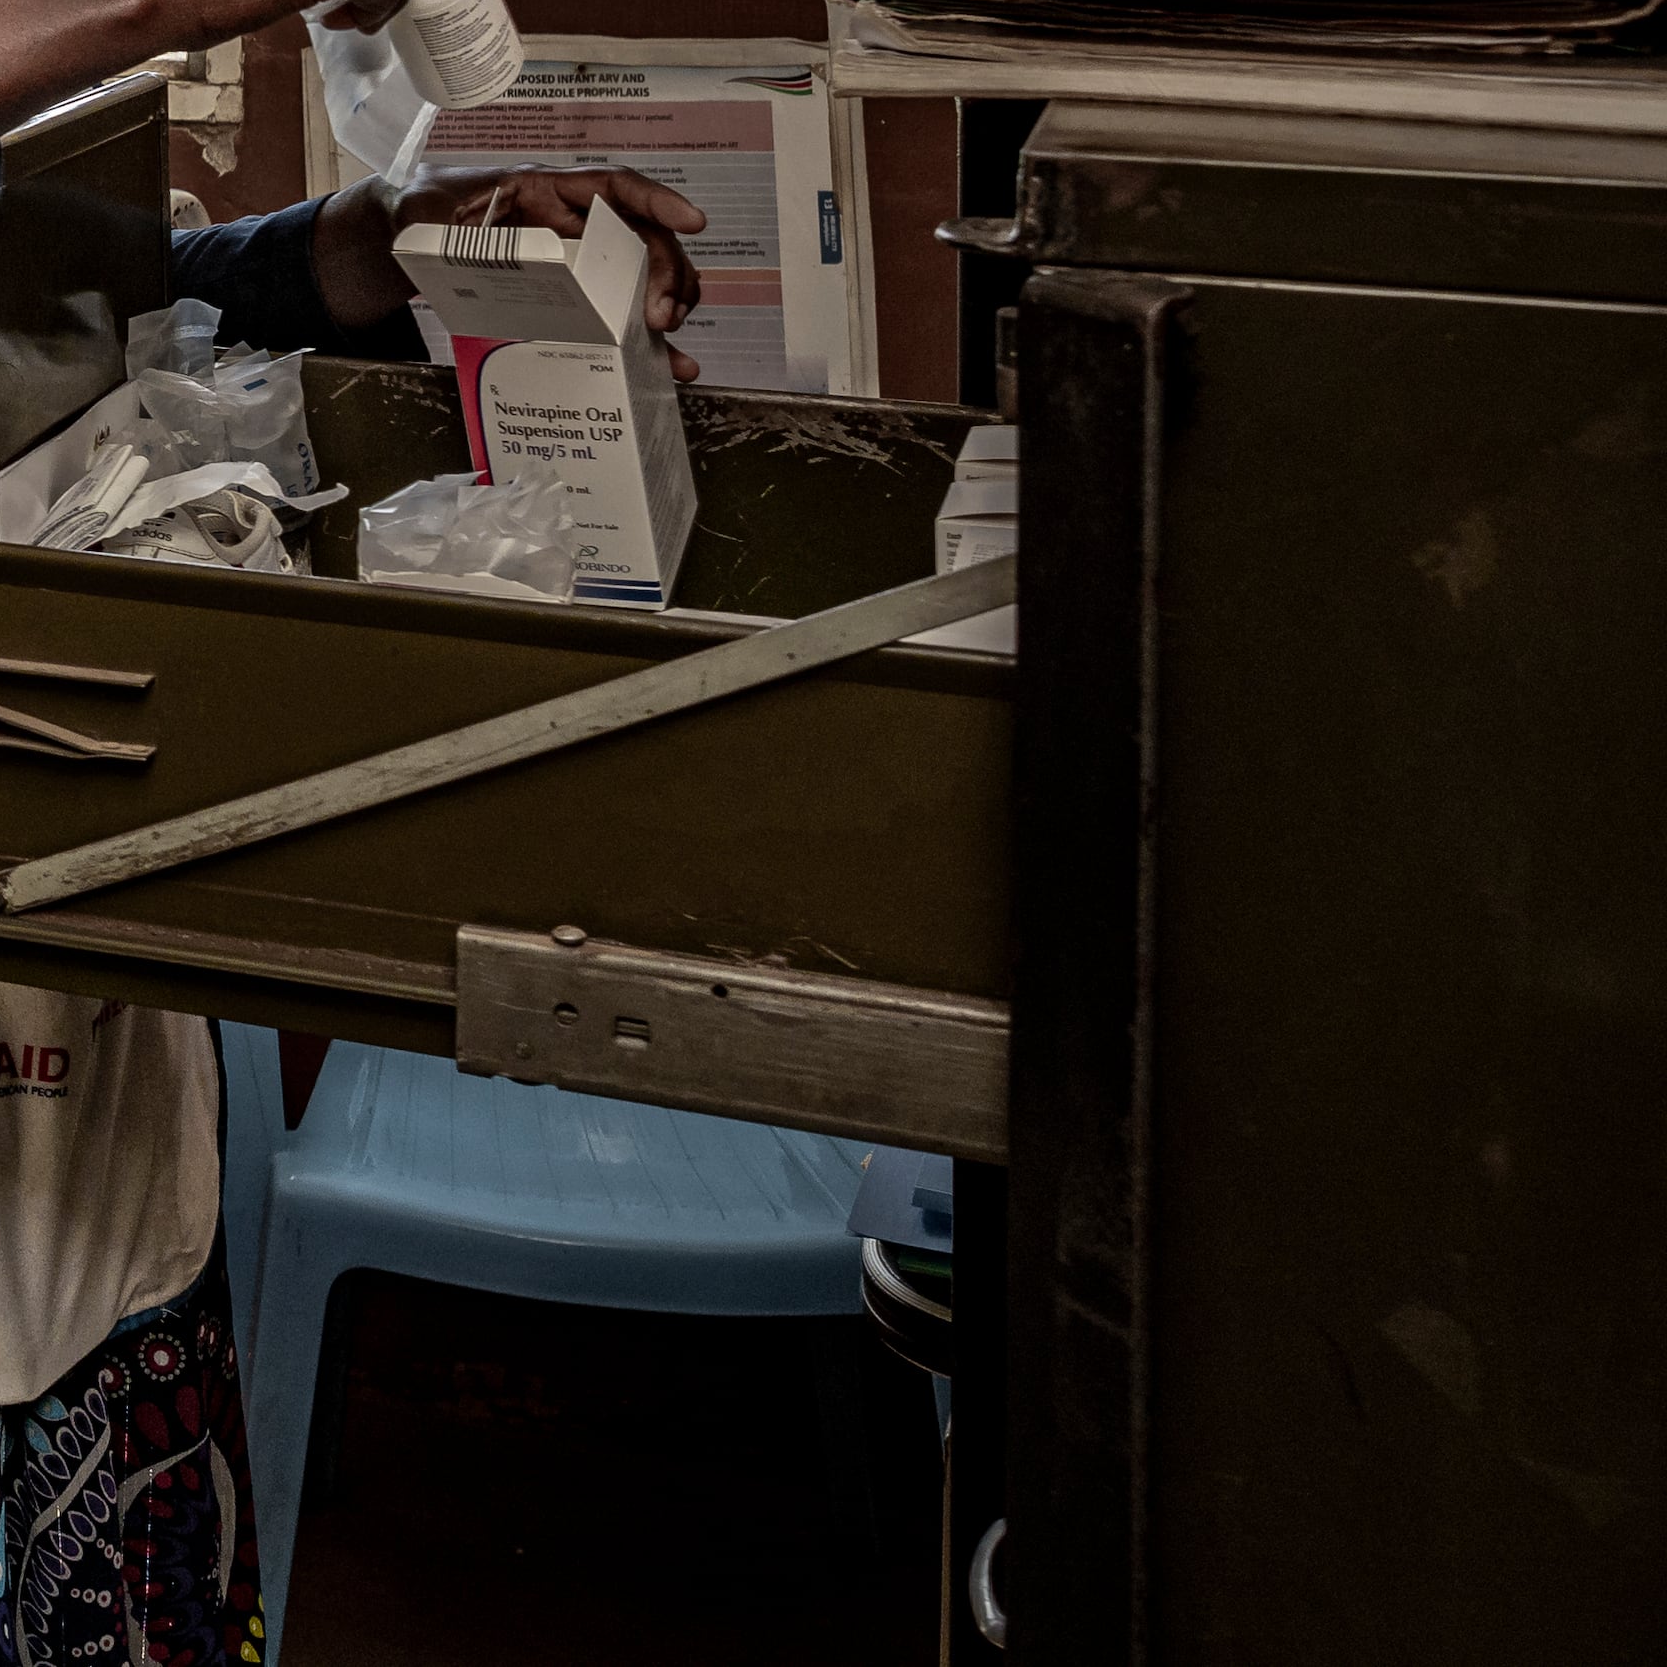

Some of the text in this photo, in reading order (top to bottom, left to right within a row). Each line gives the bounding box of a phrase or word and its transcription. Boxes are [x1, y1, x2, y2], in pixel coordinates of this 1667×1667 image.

[557, 73, 597, 85] INFANT
[598, 73, 621, 84] ARV
[622, 73, 646, 84] AND
[577, 86, 651, 98] PROPHYLAXIS
[589, 363, 615, 373] POM
[493, 400, 624, 424] Nevirapine Oral
[497, 420, 624, 442] Suspension USP
[501, 440, 598, 461] 50 mg/5 mL
[576, 486, 592, 495] mL
[131, 529, 173, 542] adidas
[31, 1085, 69, 1099] PEOPLE
